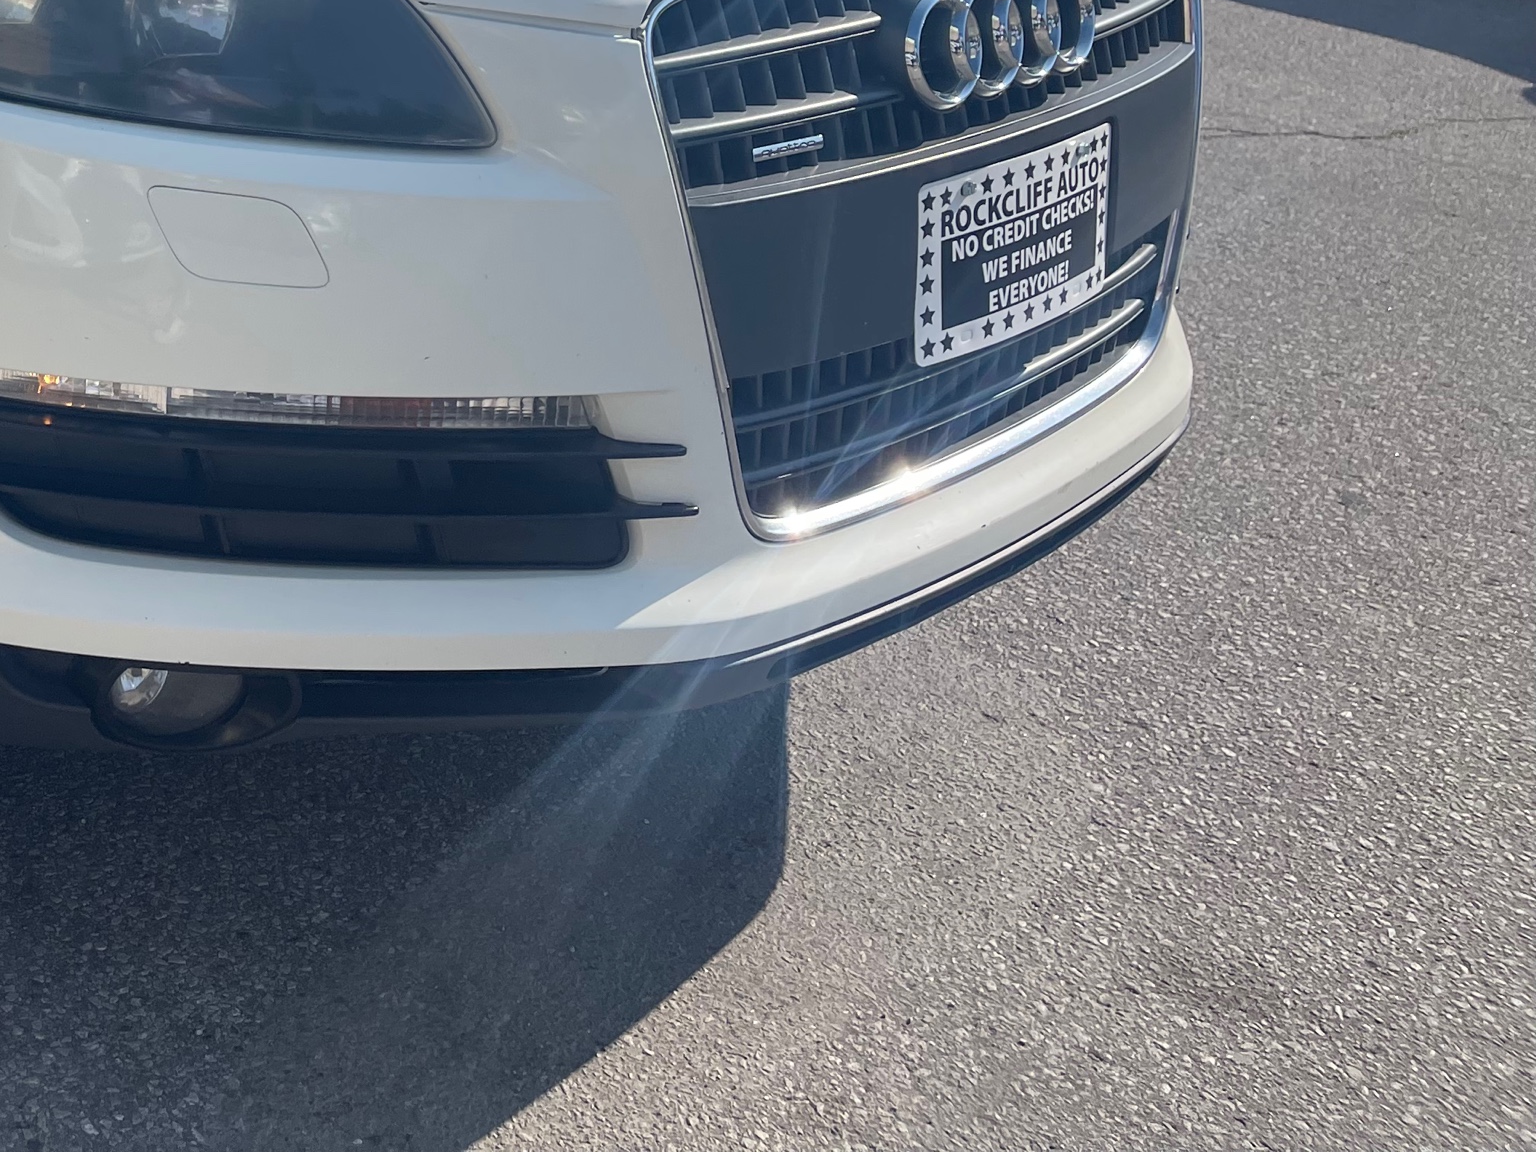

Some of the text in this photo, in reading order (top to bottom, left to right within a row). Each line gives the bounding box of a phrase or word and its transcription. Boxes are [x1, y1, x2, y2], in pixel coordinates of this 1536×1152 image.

[941, 157, 1099, 238] ROCKCLIFF AUTO
[952, 191, 1095, 262] NO CREDIT CHECKS!
[982, 229, 1073, 284] WE FINANCE
[988, 259, 1070, 313] EVERYONE!
